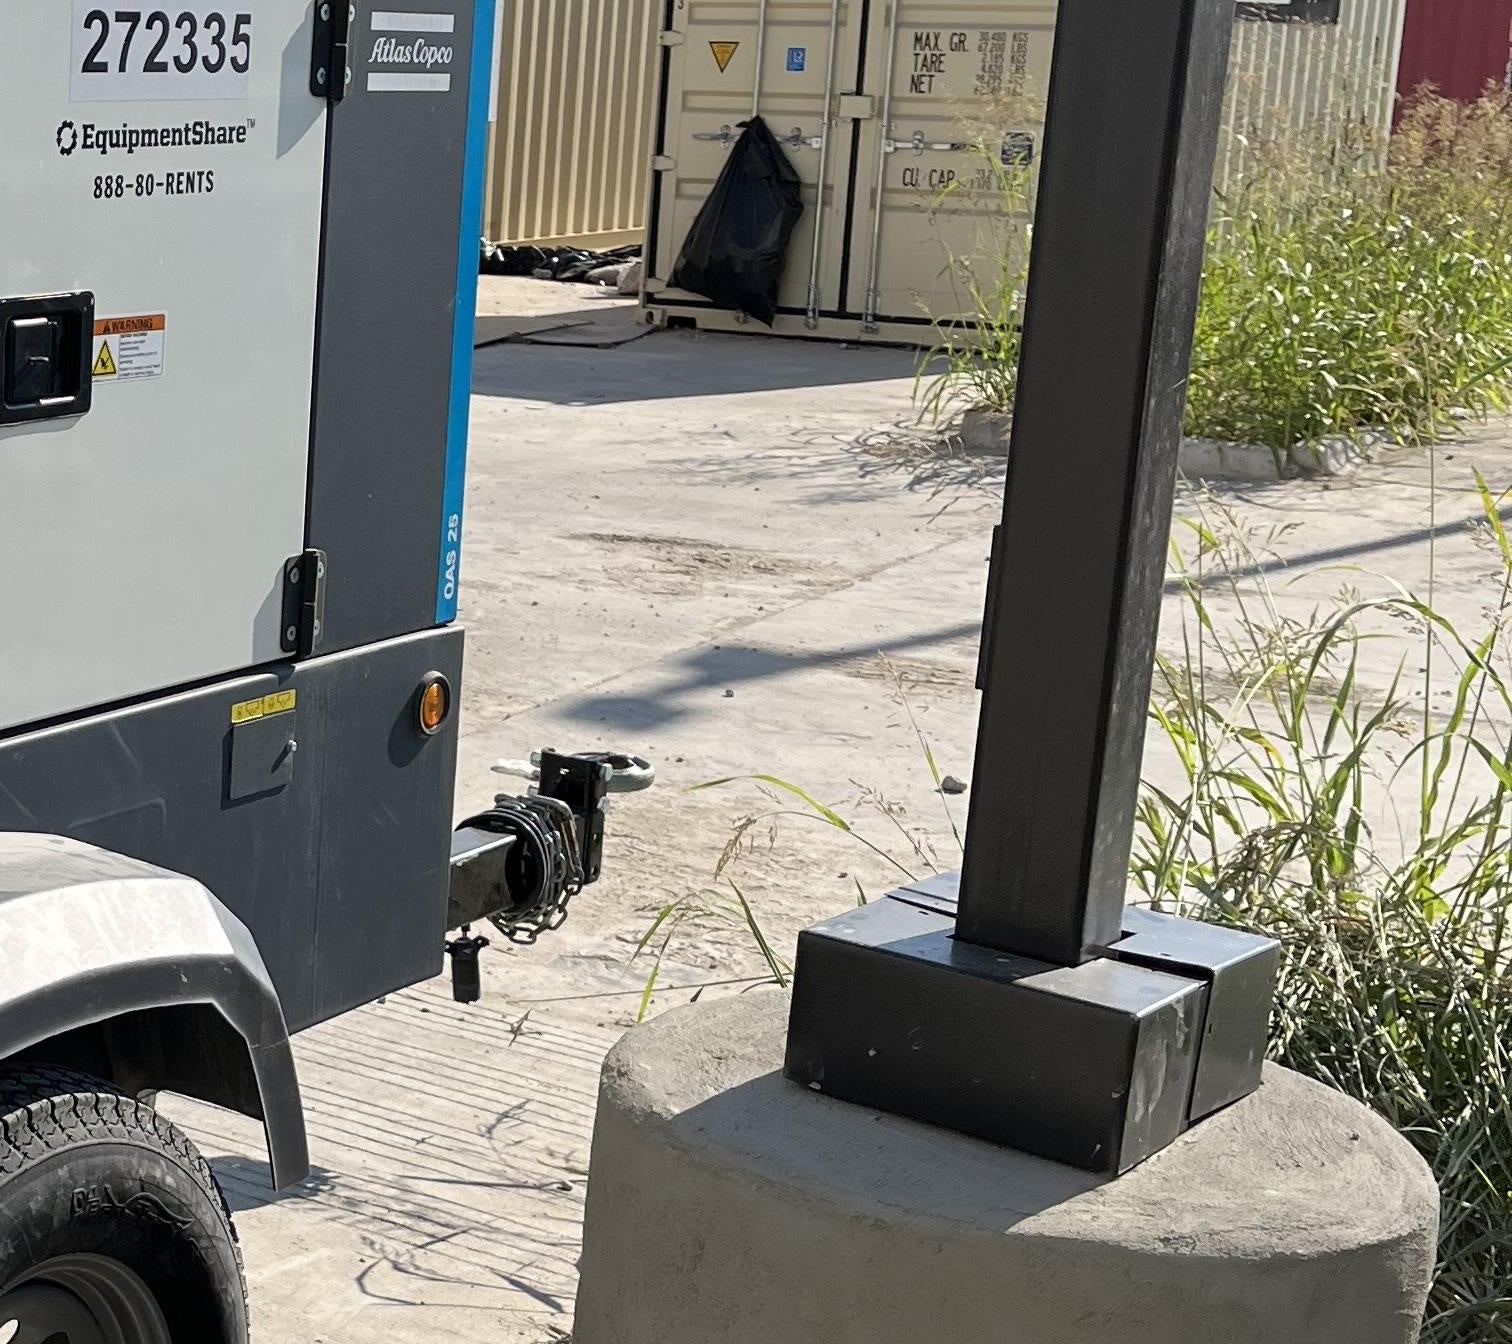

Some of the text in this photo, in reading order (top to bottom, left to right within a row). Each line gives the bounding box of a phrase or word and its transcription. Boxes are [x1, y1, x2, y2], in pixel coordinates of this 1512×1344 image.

[80, 9, 252, 74] 272335
[367, 36, 454, 69] Atlas Copco
[912, 52, 947, 73] TARE
[909, 74, 936, 94] NET
[93, 169, 215, 199] 888-80-RENTS
[111, 317, 153, 333] WARNING
[447, 513, 459, 543] 25
